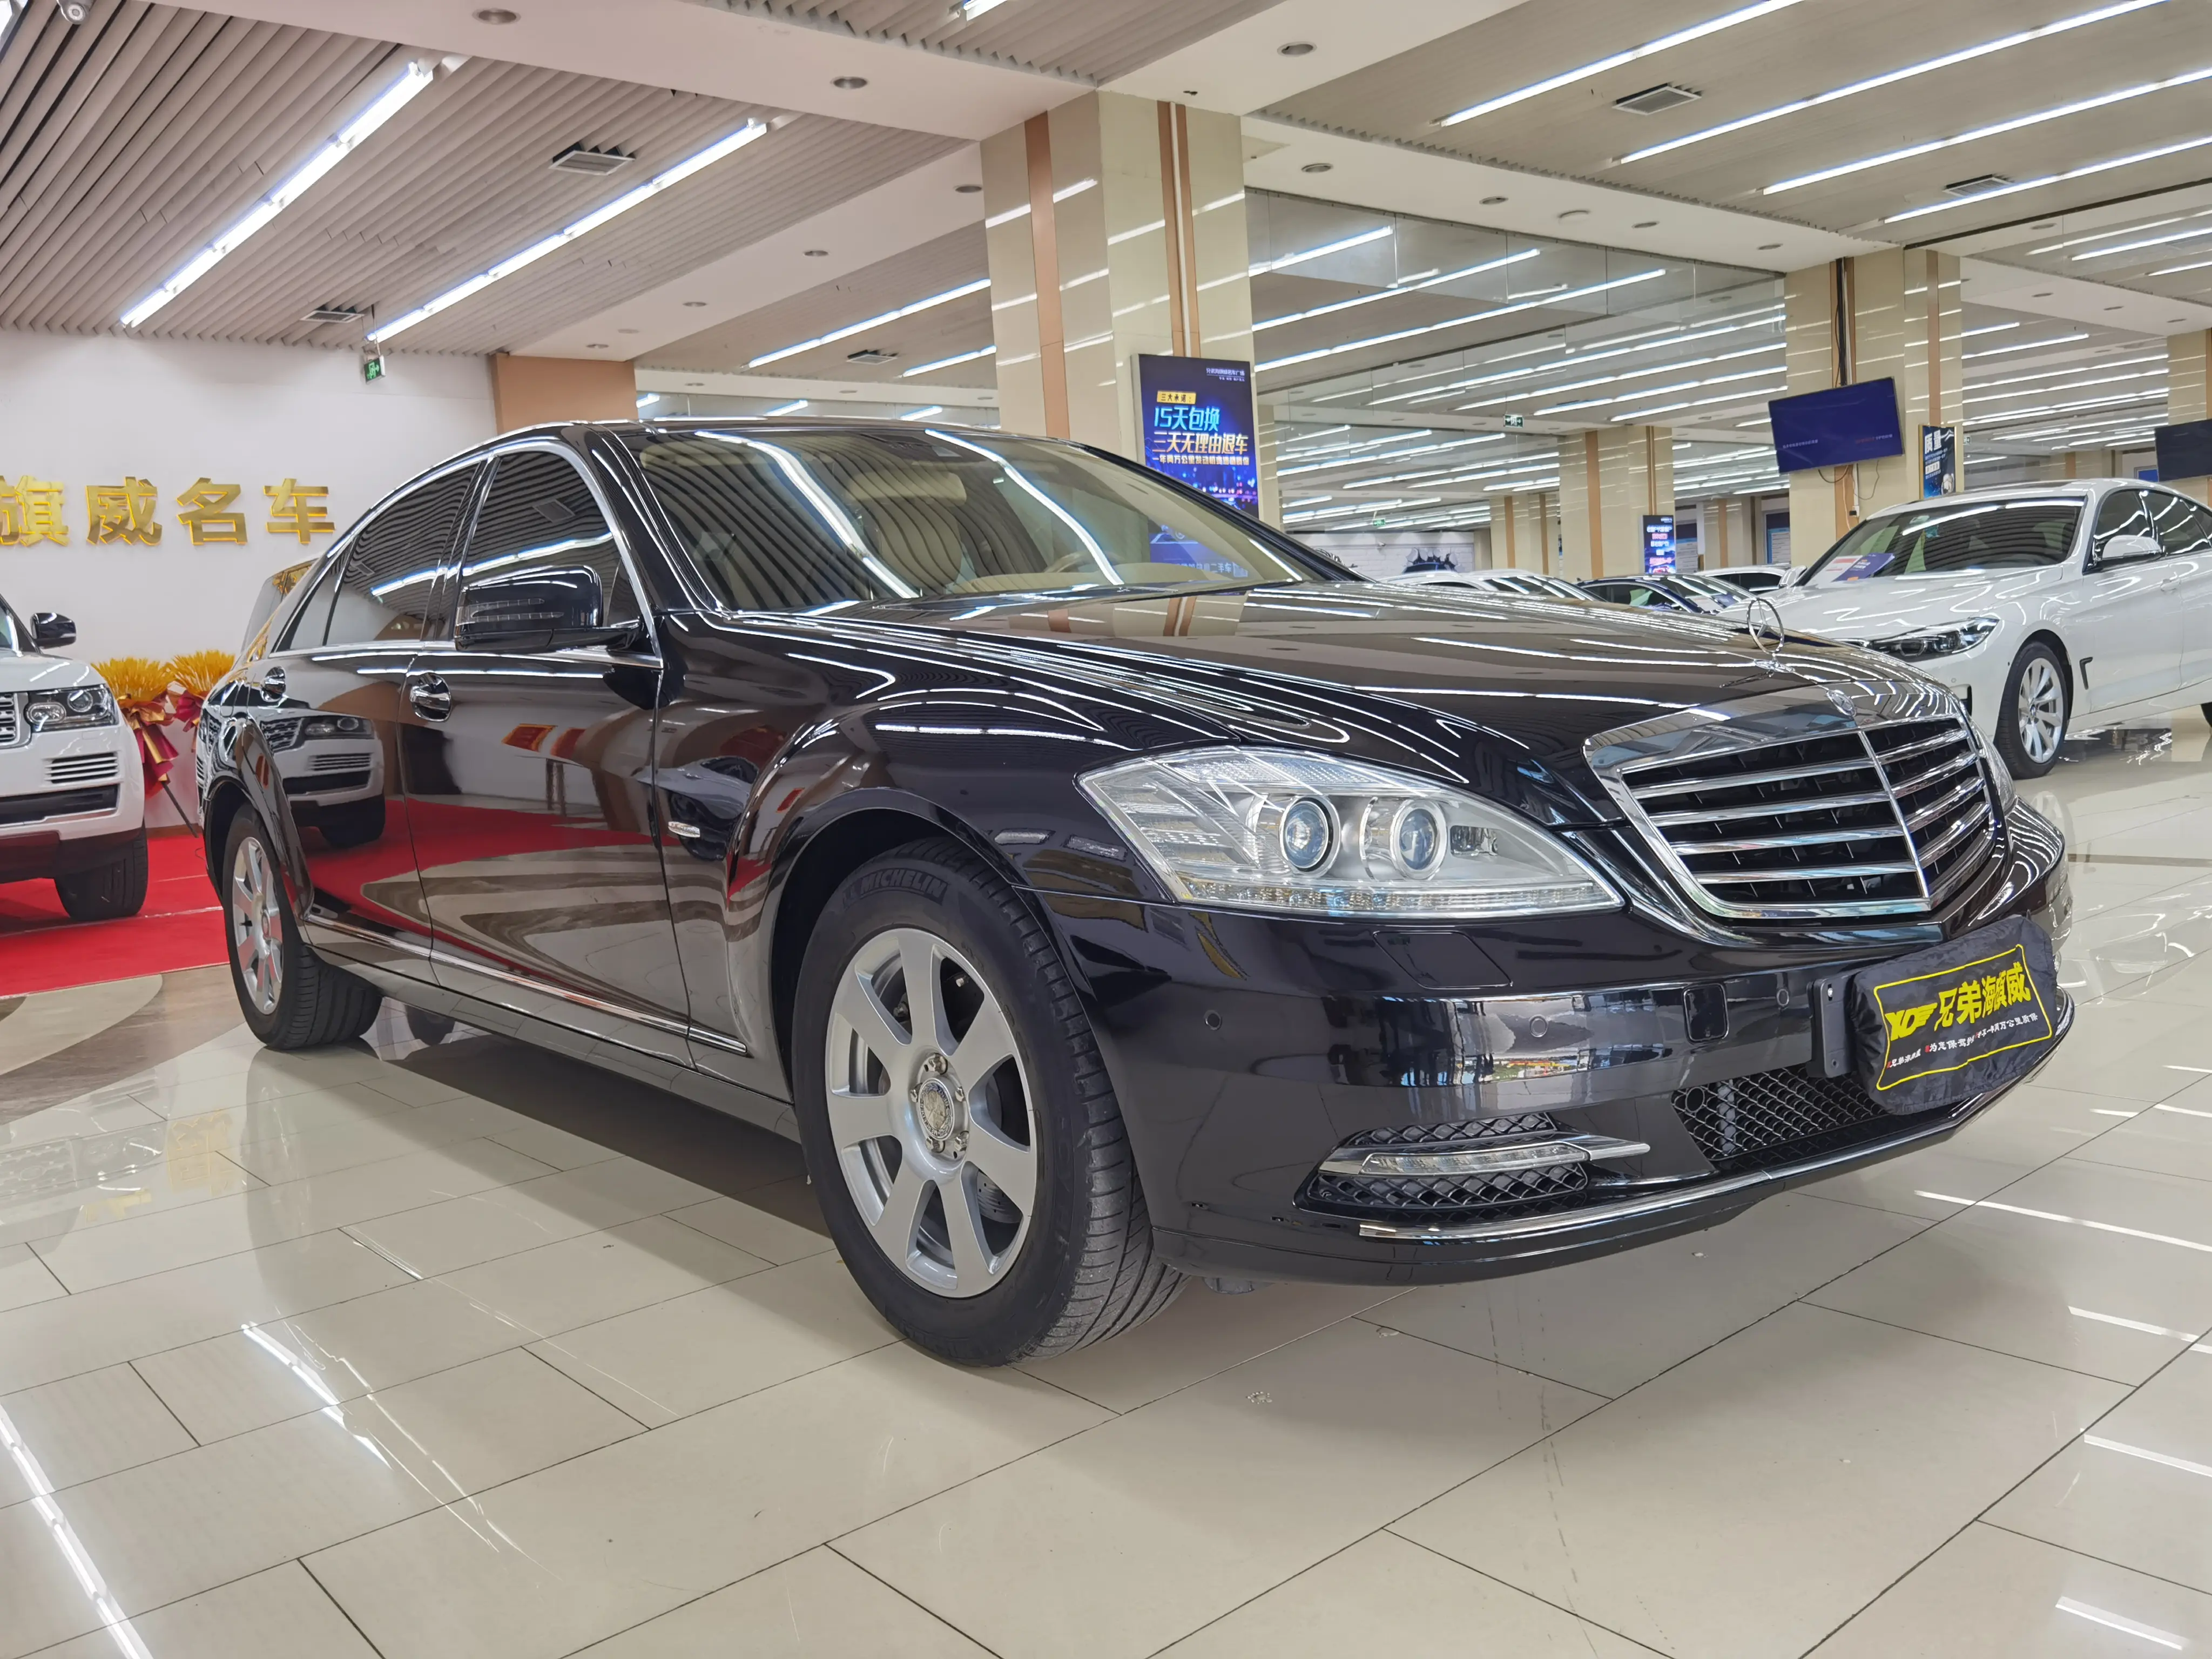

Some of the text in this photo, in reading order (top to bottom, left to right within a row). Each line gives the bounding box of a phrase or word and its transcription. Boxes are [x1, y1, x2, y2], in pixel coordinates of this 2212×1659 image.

[1154, 406, 1220, 431] 15天包换
[1152, 430, 1249, 455] 三天无理由退车
[1924, 430, 1942, 454] 质量
[0, 475, 335, 547] 旗威名车
[861, 868, 948, 898] MICHELIN
